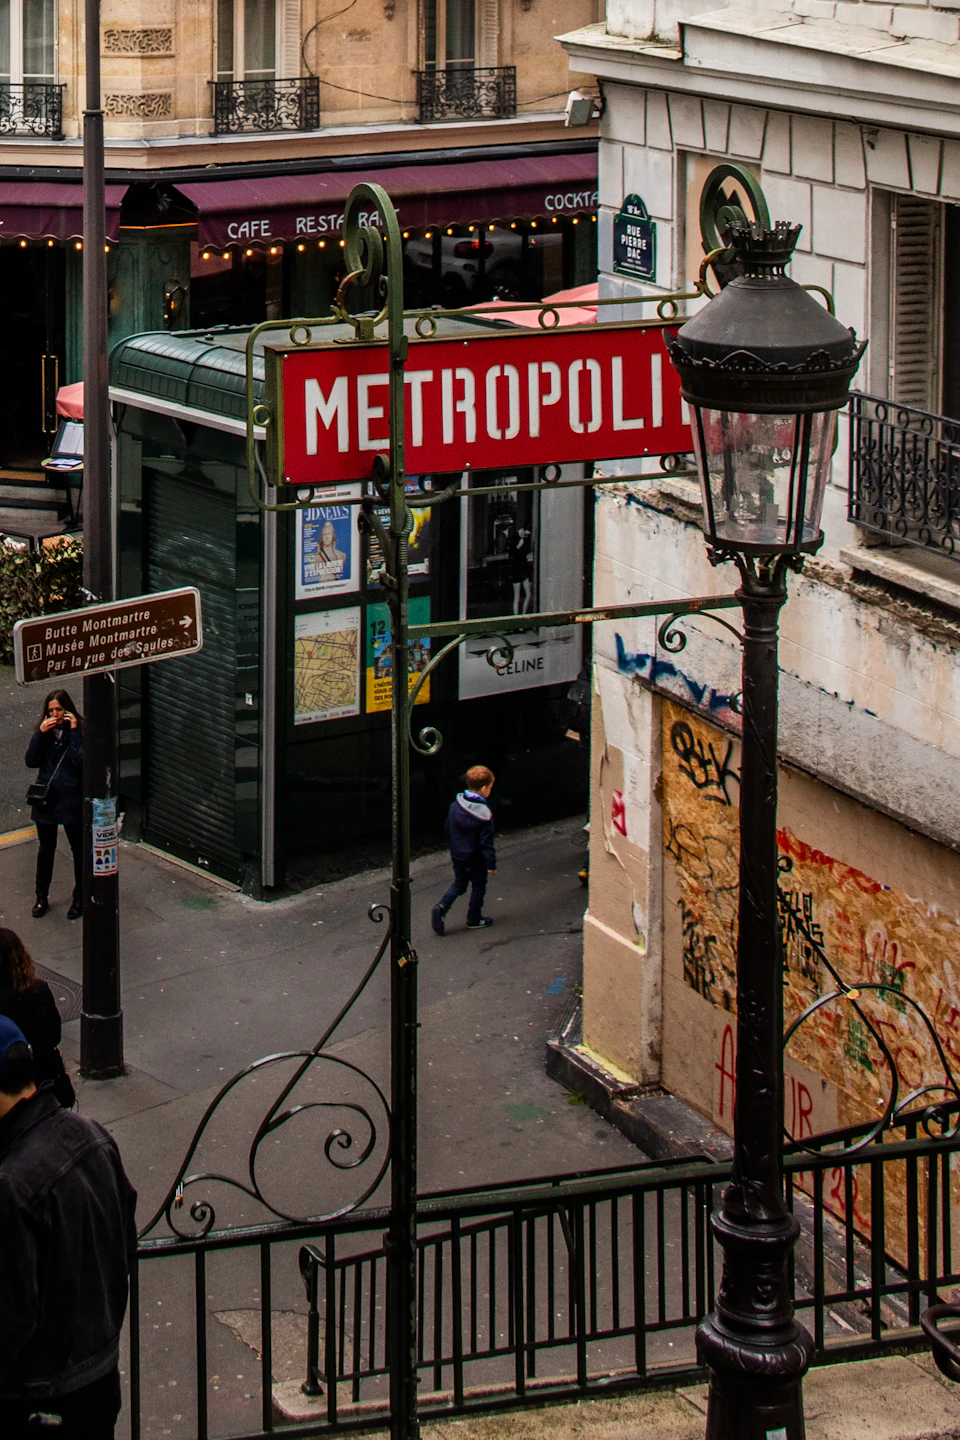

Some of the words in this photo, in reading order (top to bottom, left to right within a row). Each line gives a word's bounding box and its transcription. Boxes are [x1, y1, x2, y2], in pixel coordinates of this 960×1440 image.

[227, 219, 272, 240] CAFE
[296, 208, 400, 234] RESTARA
[627, 224, 641, 238] RUE
[620, 234, 647, 250] PIERRE
[626, 247, 641, 260] DAC
[44, 624, 78, 641] Butte
[82, 610, 150, 633] Montmartre
[370, 620, 386, 636] 12
[45, 639, 84, 657] Musée
[89, 624, 157, 648] Montmartre
[46, 659, 66, 673] Par
[71, 654, 82, 667] la
[86, 651, 105, 665] rue
[110, 646, 130, 660] des
[135, 636, 174, 654] Saules
